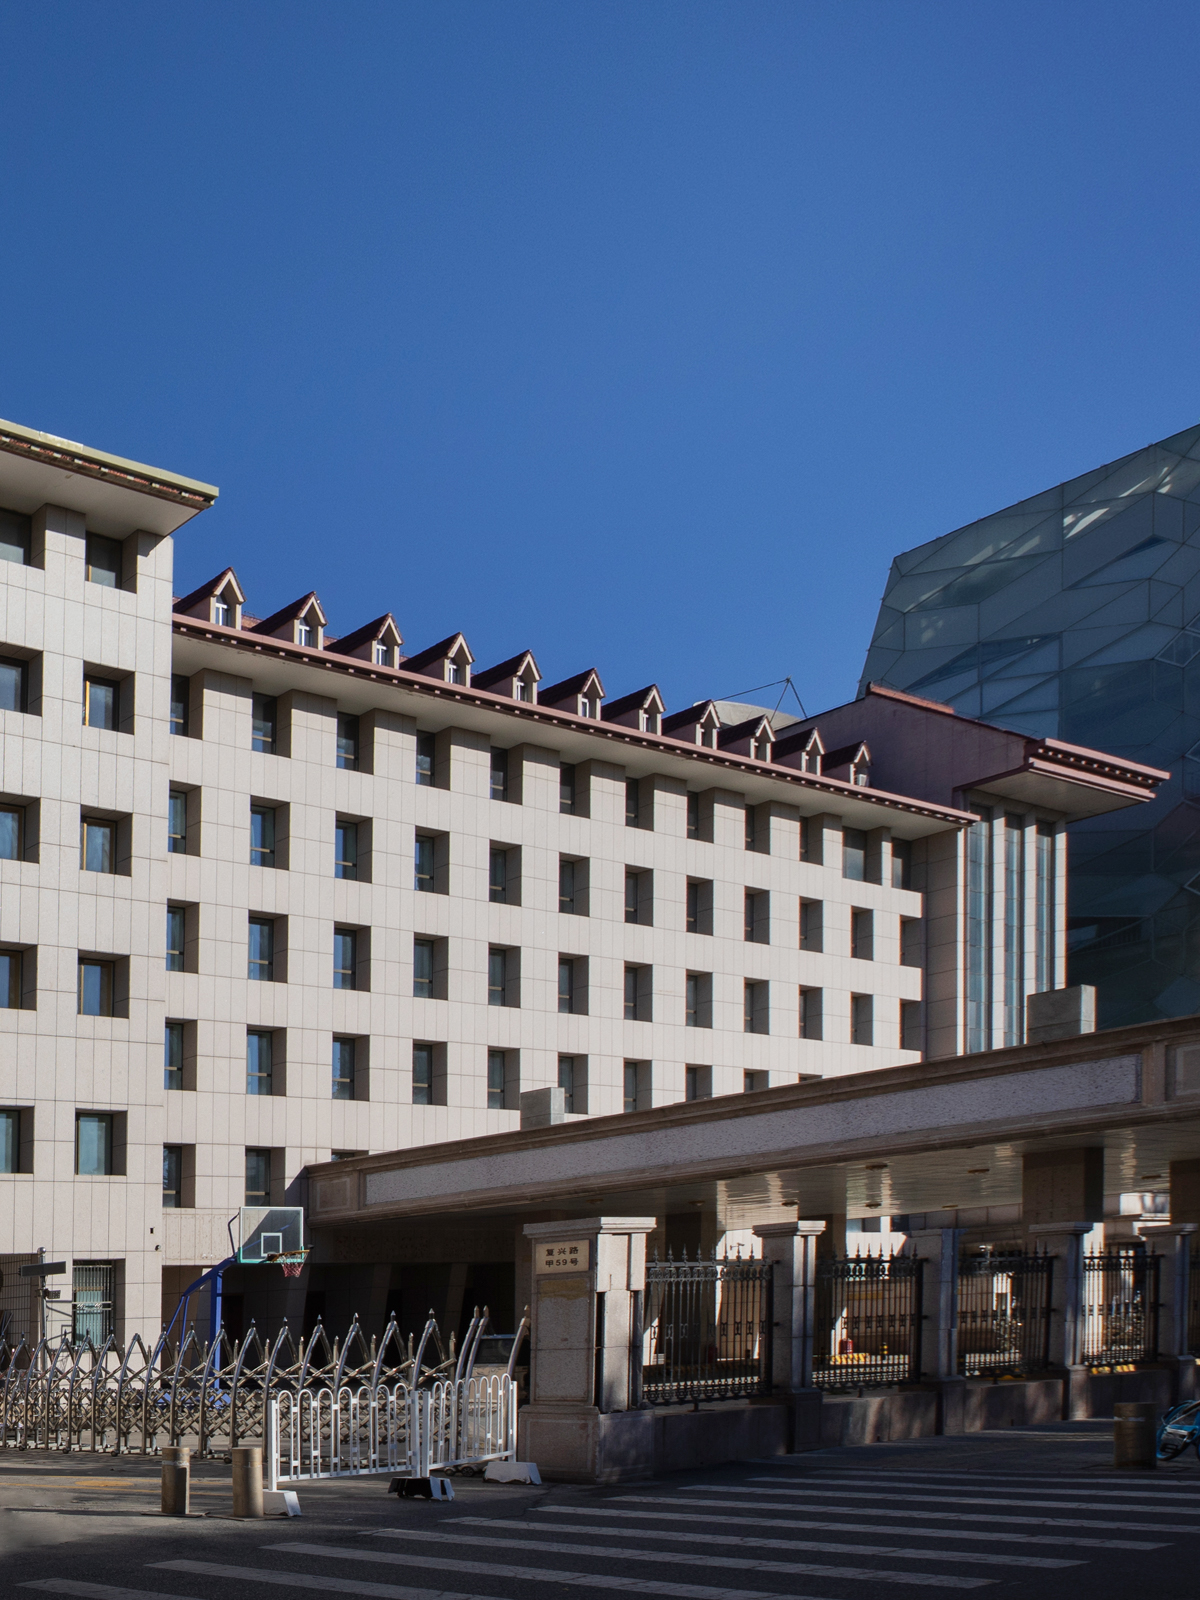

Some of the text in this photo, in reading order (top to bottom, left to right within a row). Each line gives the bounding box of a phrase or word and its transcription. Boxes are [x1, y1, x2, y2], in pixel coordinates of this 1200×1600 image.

[545, 1246, 579, 1256] 复兴路
[545, 1258, 579, 1268] 甲59号
